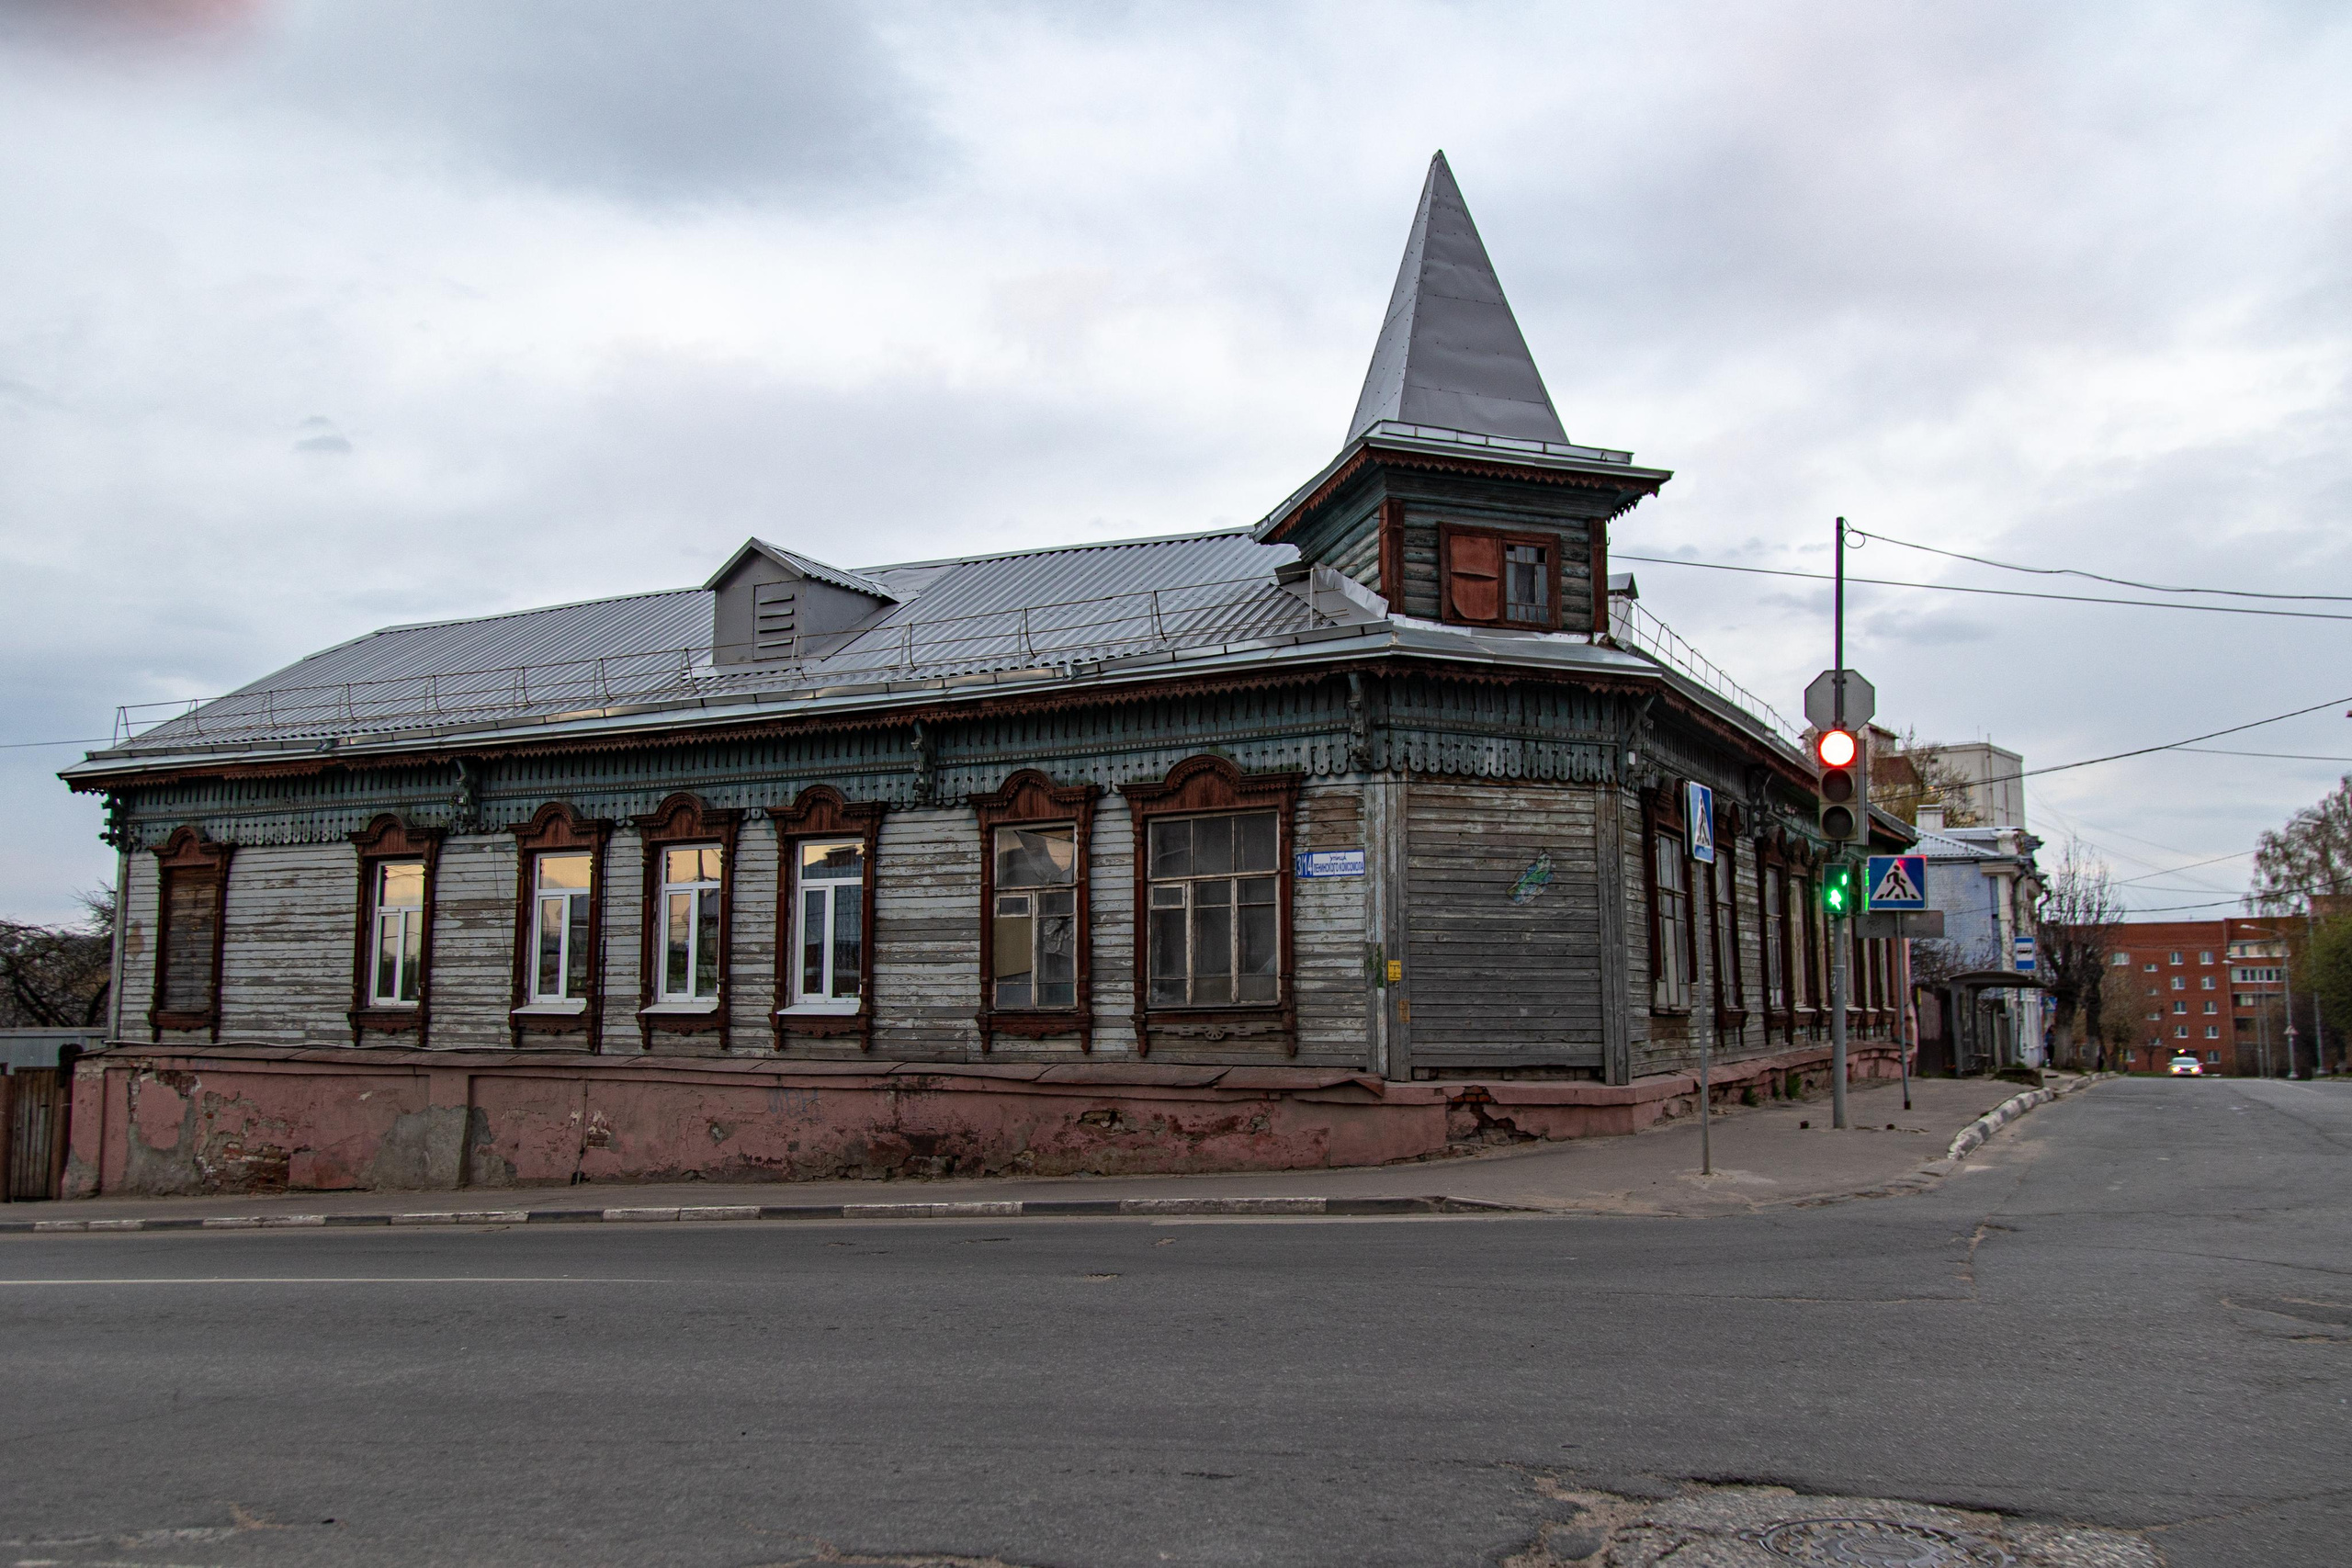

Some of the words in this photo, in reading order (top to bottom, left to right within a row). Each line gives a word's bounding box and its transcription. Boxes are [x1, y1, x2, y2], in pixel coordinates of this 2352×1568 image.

[1296, 855, 1313, 875] 3/14
[1314, 863, 1339, 873] ЛЕНИНСКОГО
[1340, 861, 1364, 872] КОМСОМОЛА
